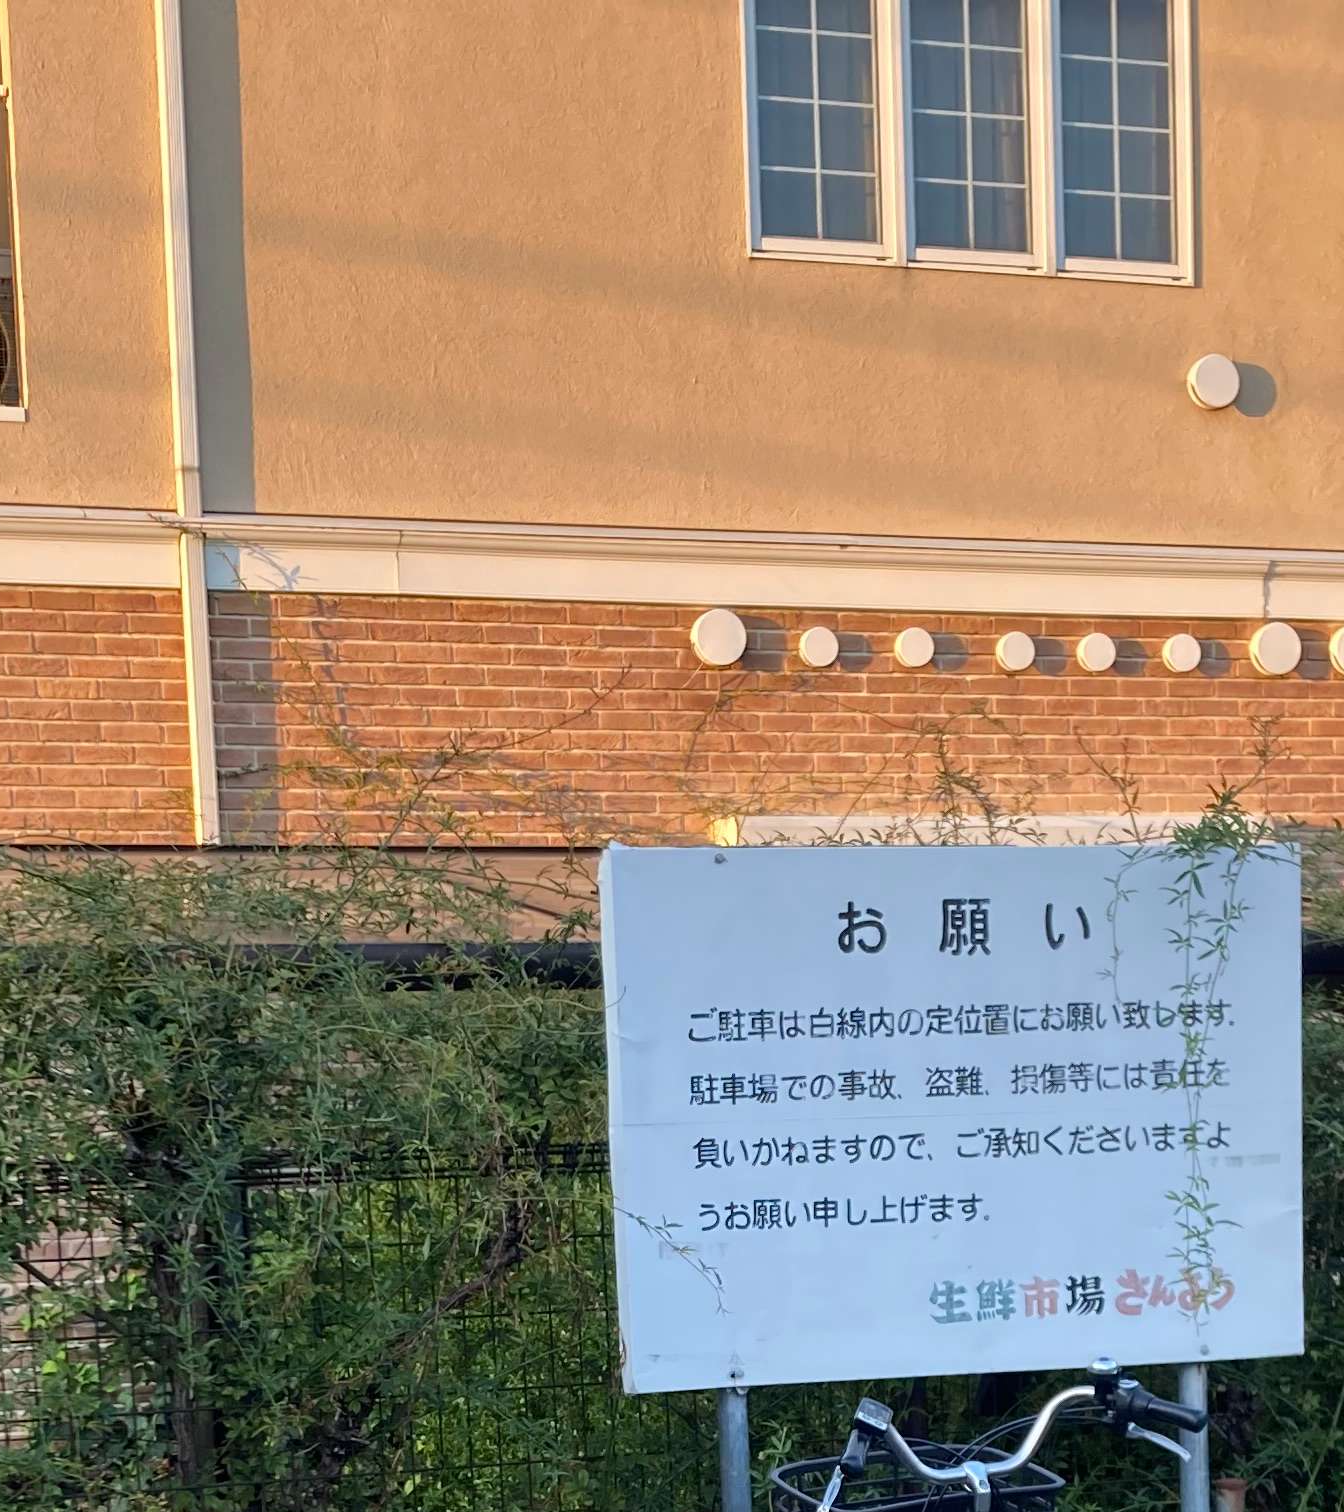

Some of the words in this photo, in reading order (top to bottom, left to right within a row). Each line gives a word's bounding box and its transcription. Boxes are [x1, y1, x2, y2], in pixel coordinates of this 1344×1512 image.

[837, 897, 1092, 956] お願い
[688, 1057, 1231, 1107] 駐車場での事故、盗難、損傷等には責任を
[692, 1121, 1231, 1170] 負いかねますので、ご承知くださいますよ
[697, 1194, 991, 1233] うお願い申し上げます。
